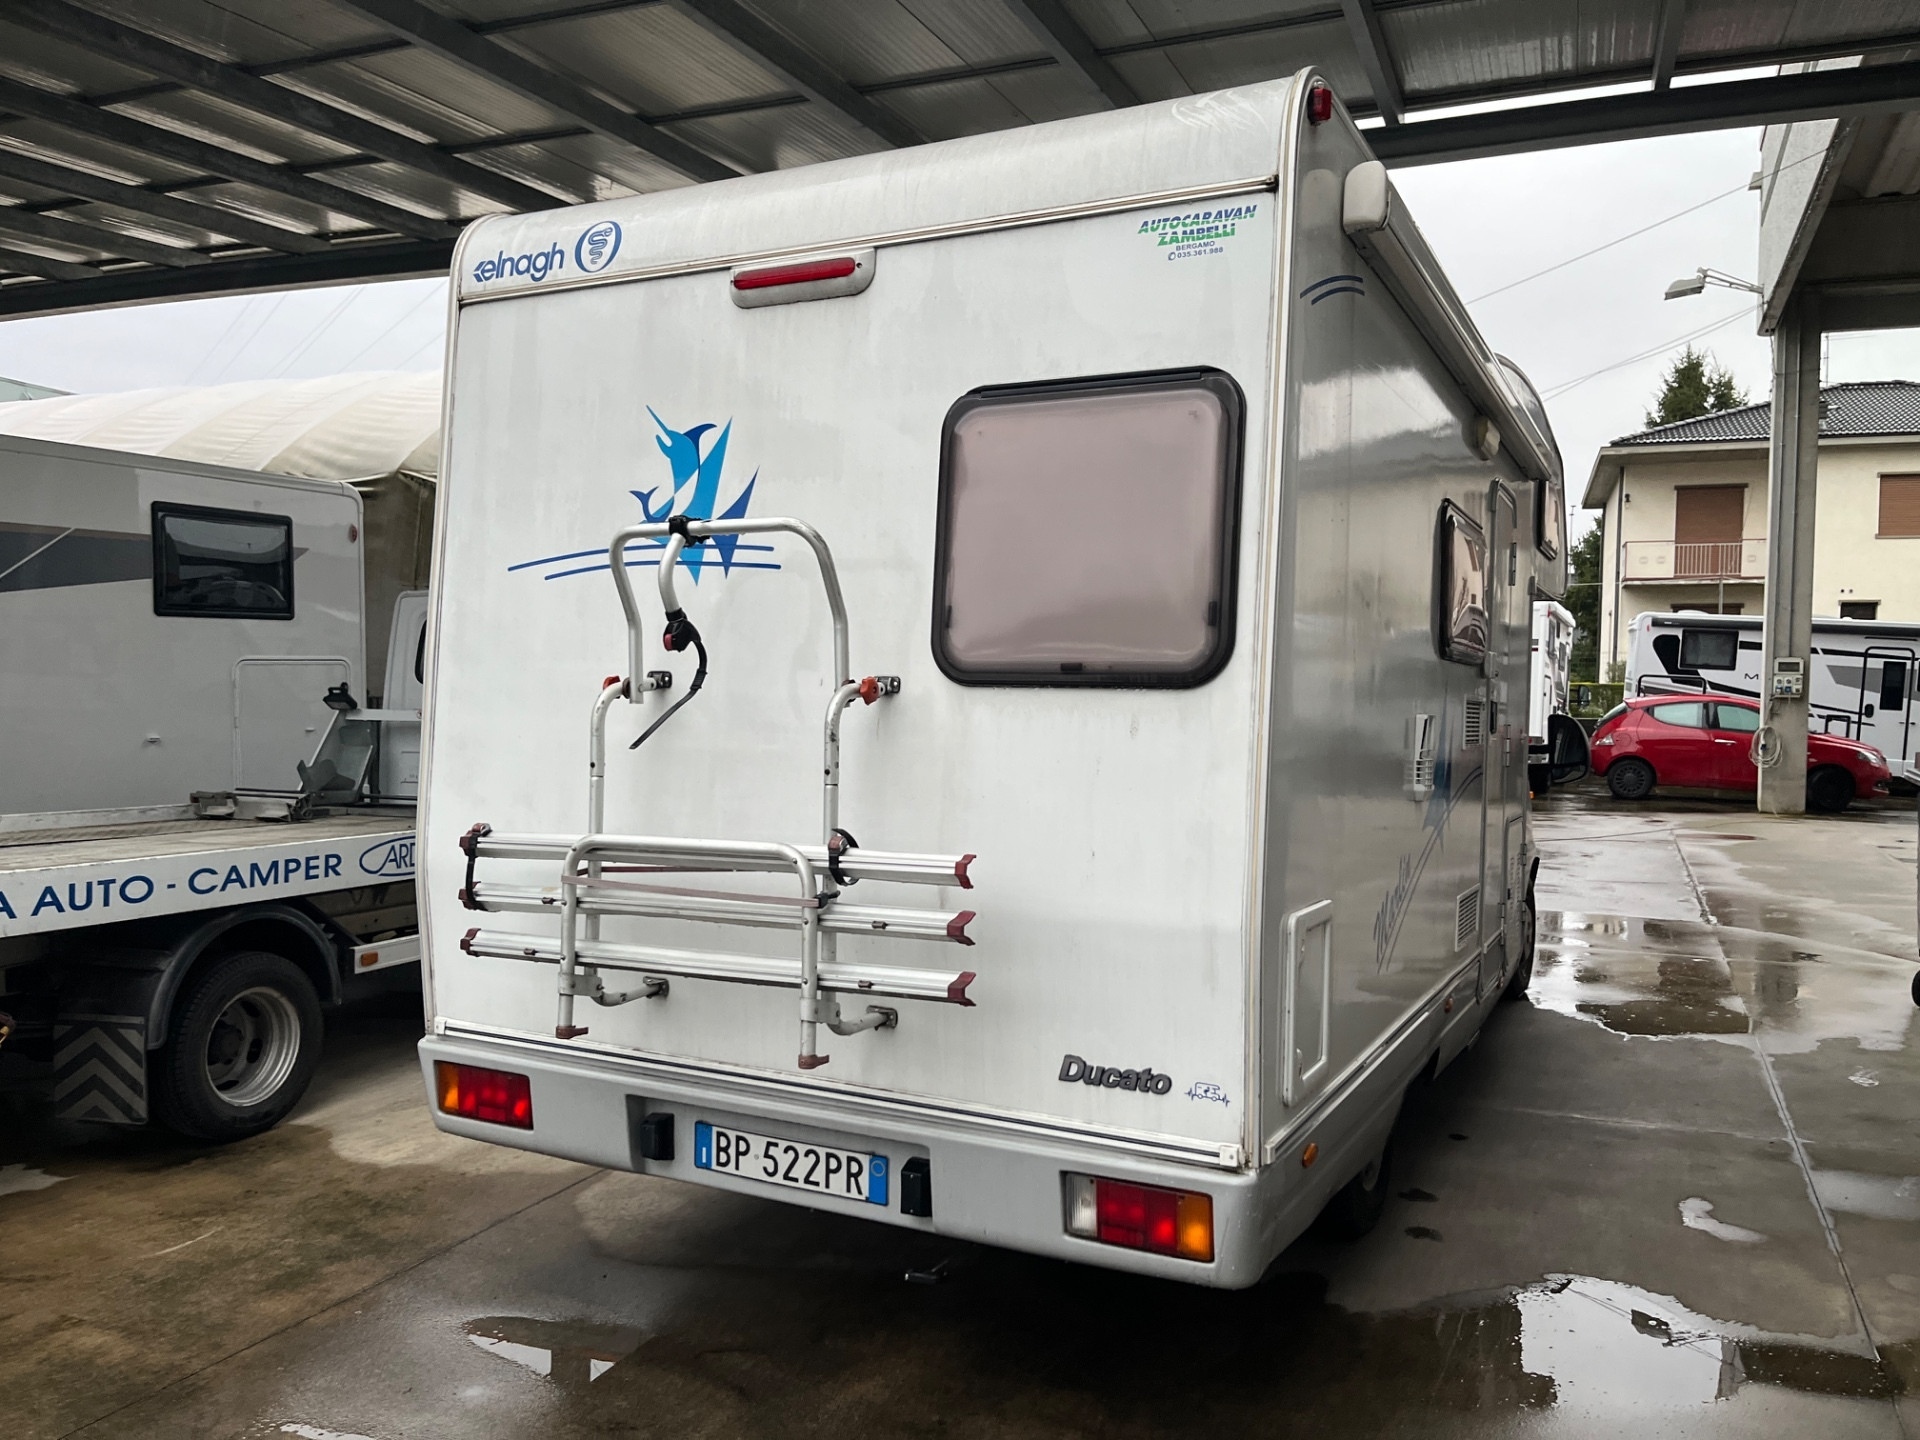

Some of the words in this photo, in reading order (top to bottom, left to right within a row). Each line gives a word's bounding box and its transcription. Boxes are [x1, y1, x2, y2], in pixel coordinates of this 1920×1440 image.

[1138, 205, 1257, 234] AUTOCARAVAN
[1157, 223, 1235, 246] ZAMBELLI
[473, 242, 564, 282] elnagh
[1176, 240, 1215, 251] BERGAMO
[30, 875, 154, 917] AUTO
[188, 853, 342, 895] CAMPER
[1058, 1054, 1172, 1095] Ducato
[716, 1130, 751, 1171] BP
[763, 1141, 864, 1195] 522PR
